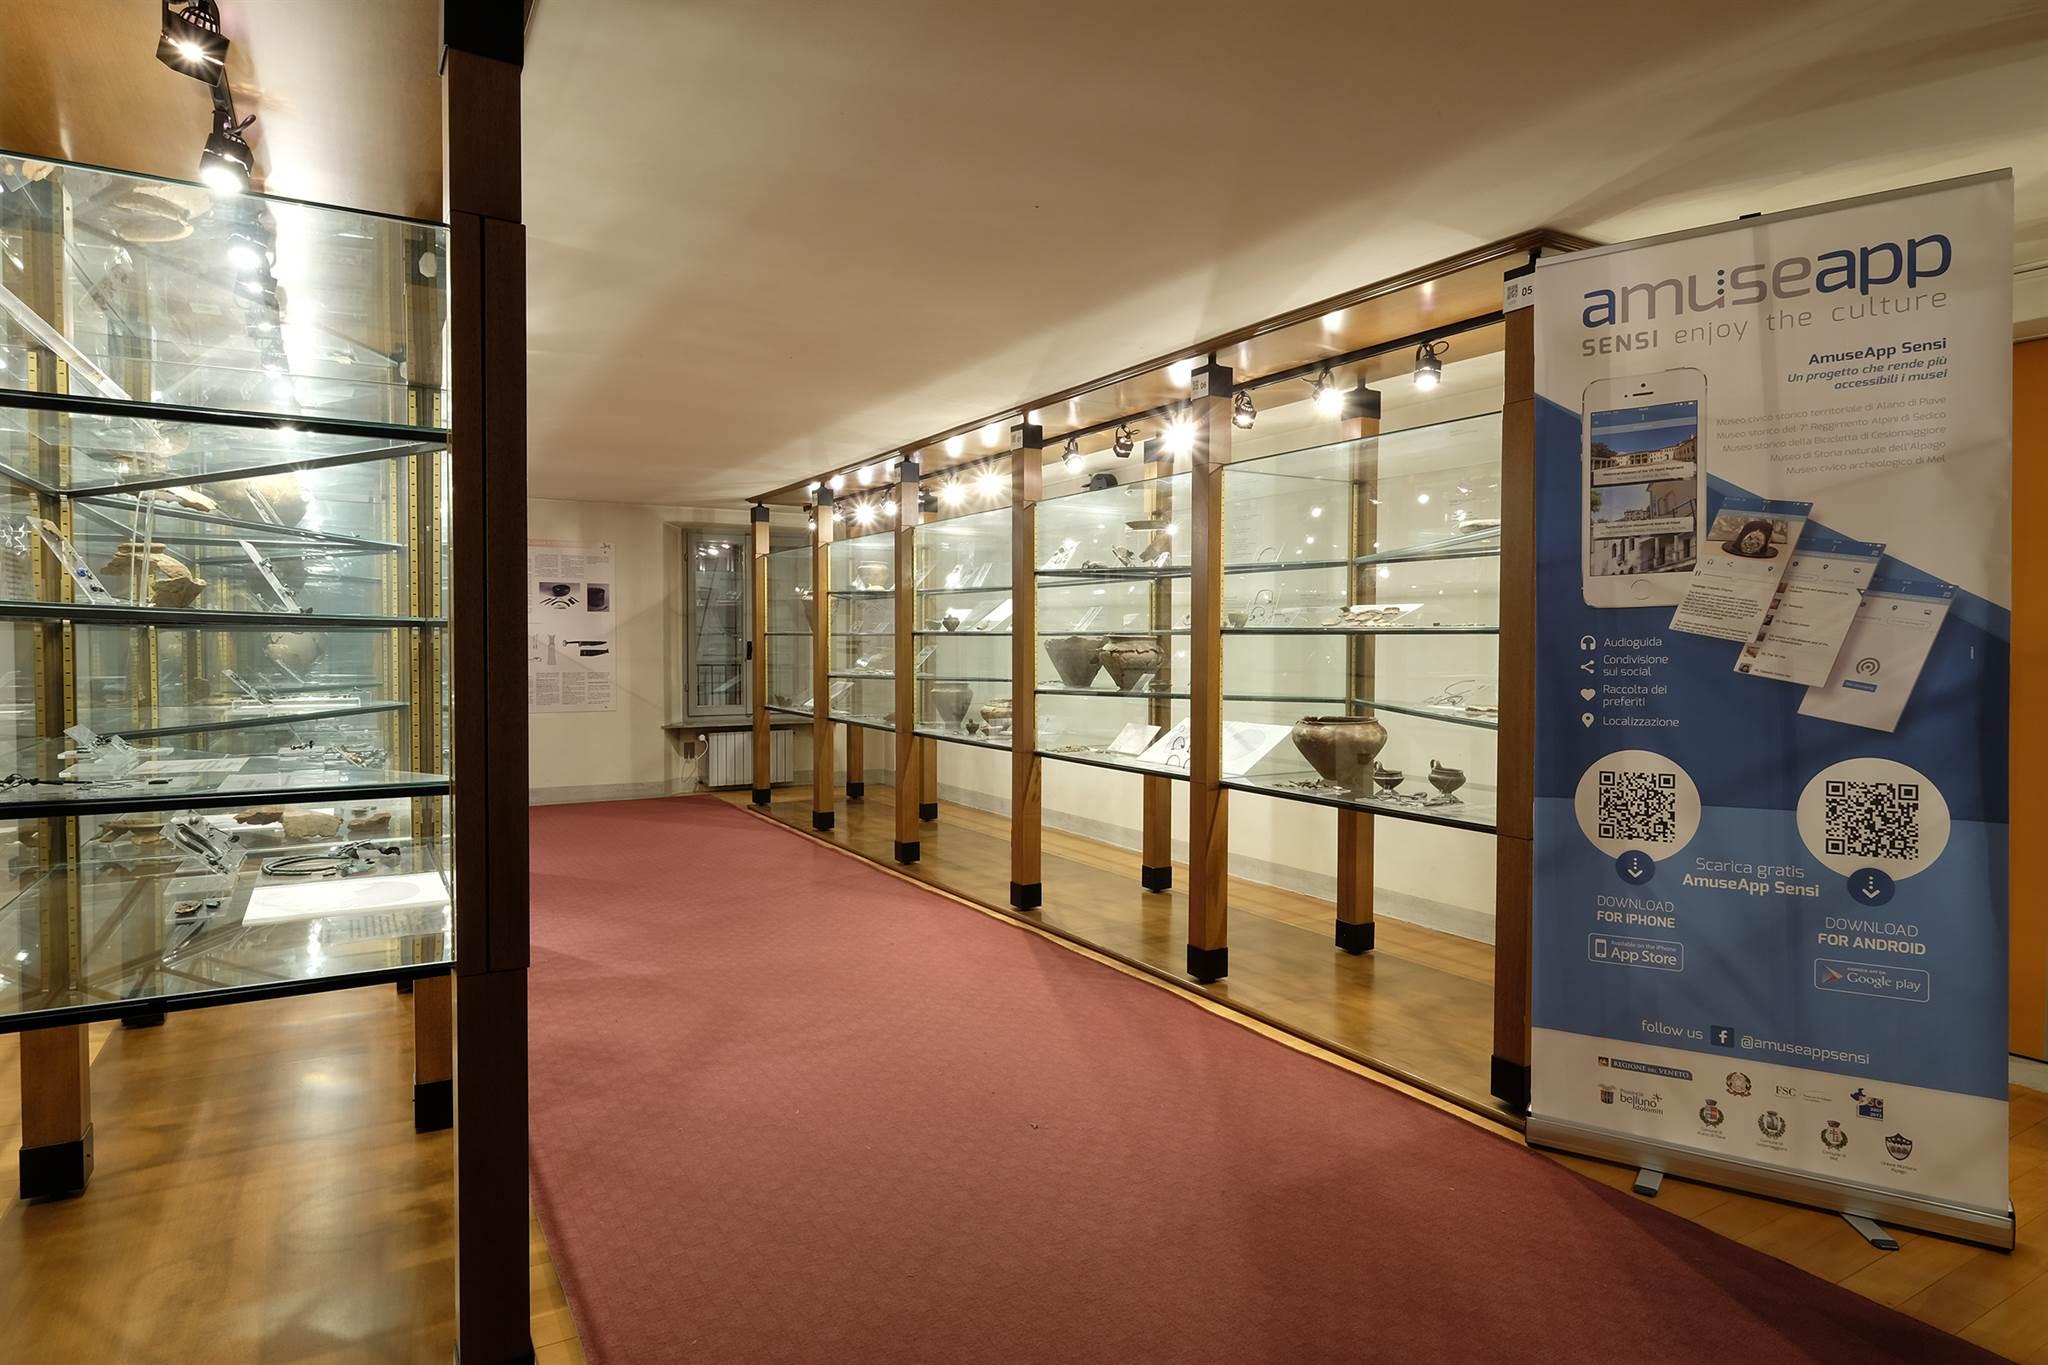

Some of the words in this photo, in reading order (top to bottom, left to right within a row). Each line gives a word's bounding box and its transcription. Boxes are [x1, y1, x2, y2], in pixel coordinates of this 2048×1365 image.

[1521, 285, 1533, 296] 05
[1582, 234, 1952, 328] amuseapp
[1582, 330, 1658, 357] SENSI
[1674, 319, 1748, 345] enjoy
[1766, 309, 1812, 331] the
[1831, 292, 1948, 322] culture
[1808, 345, 1897, 365] AmuseApp
[1902, 337, 1947, 353] Sensi
[1788, 373, 1803, 383] Un
[1806, 367, 1859, 383] progetto
[1862, 364, 1884, 374] che
[1888, 358, 1925, 371] rende
[1927, 355, 1947, 369] più
[1834, 374, 1898, 390] accessibili
[1901, 373, 1905, 383] i
[1908, 369, 1948, 382] musei
[1716, 417, 1746, 426] Museo
[1748, 415, 1774, 424] civico
[1775, 410, 1808, 419] storico
[1810, 404, 1863, 417] territoriale
[1864, 403, 1873, 412] di
[1876, 400, 1906, 409] Alano
[1908, 399, 1917, 407] di
[1919, 397, 1946, 405] Piave
[1716, 431, 1746, 439] Museo
[1748, 427, 1780, 436] storico
[1782, 425, 1796, 433] del
[1871, 415, 1899, 425] Alpini
[1901, 413, 1910, 421] di
[1912, 412, 1946, 421] Sedico
[1722, 444, 1752, 452] Museo
[1754, 440, 1786, 449] storico
[1788, 437, 1812, 446] della
[1860, 432, 1869, 440] di
[1770, 454, 1801, 462] Museo
[1803, 451, 1812, 460] di
[1814, 448, 1842, 458] Storia
[1844, 445, 1887, 455] naturale
[1786, 465, 1818, 474] Museo
[1819, 463, 1847, 472] civico
[1849, 459, 1912, 470] archeologico
[1915, 456, 1925, 464] di
[1927, 455, 1945, 464] Mel
[1603, 637, 1662, 650] Audioguida
[1603, 654, 1669, 665] Condivisione
[1603, 668, 1618, 677] sui
[1620, 666, 1652, 677] social
[1603, 684, 1649, 695] Raccolta
[1651, 684, 1668, 695] dei
[1602, 696, 1646, 708] preferiti
[1603, 716, 1680, 727] Localizzazione
[1695, 857, 1752, 874] Scarica
[1757, 863, 1805, 879] gratis
[1682, 873, 1770, 896] AmuseApp
[1775, 881, 1820, 897] Sensi
[1597, 895, 1674, 913] DOWNLOAD
[1597, 910, 1623, 923] FOR
[1825, 917, 1919, 938] DOWNLOAD
[1818, 933, 1848, 948] FOR
[1853, 937, 1926, 955] ANDROID
[1611, 946, 1639, 963] App
[1641, 950, 1677, 966] Store
[1847, 972, 1892, 989] Google
[1895, 979, 1921, 992] play
[1641, 1019, 1683, 1037] follow
[1687, 1028, 1704, 1040] us
[1740, 1035, 1871, 1065] @amuseappsensi
[1612, 1060, 1647, 1072] REGIONE
[1659, 1068, 1690, 1079] VENETO
[1775, 1085, 1797, 1097] FSC
[1619, 1094, 1657, 1109] belluno
